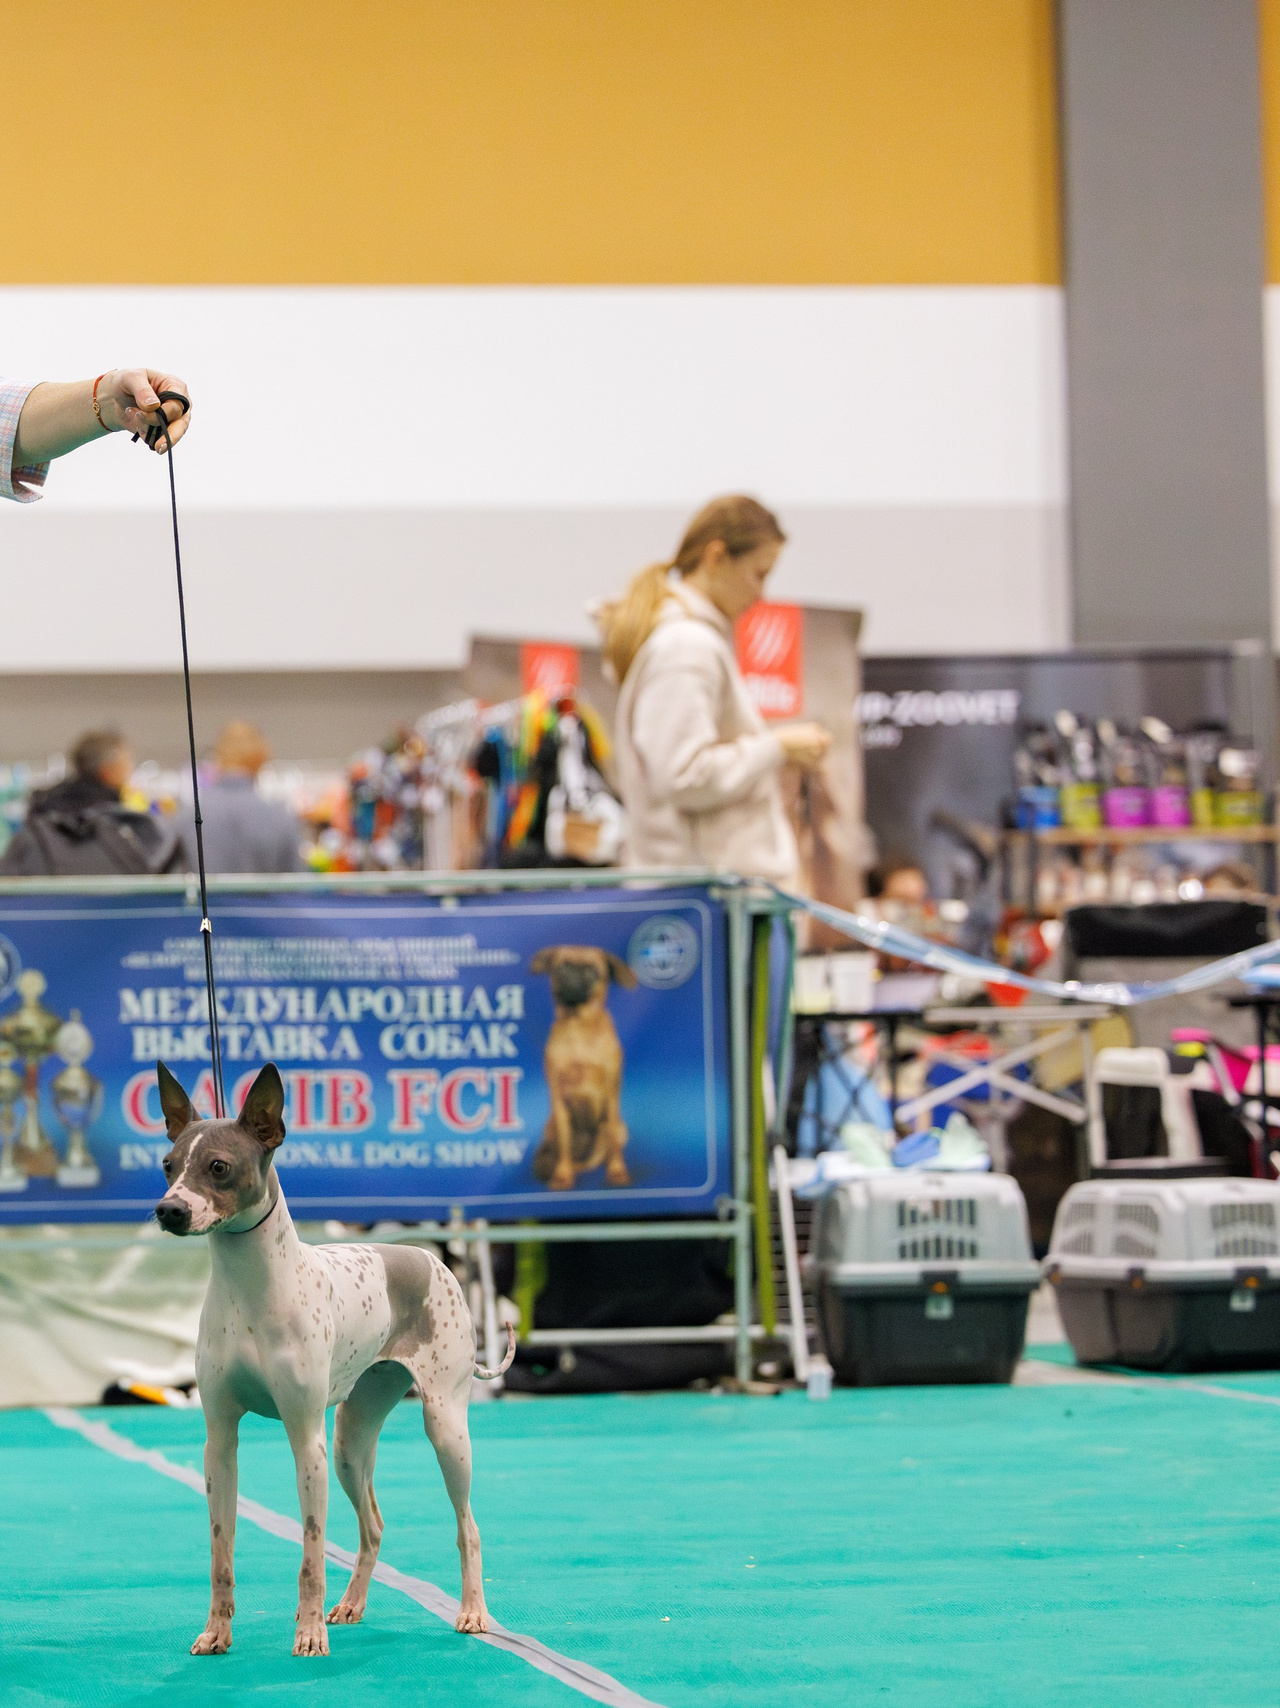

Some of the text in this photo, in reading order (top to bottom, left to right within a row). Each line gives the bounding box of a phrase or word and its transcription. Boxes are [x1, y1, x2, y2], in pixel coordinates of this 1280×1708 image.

[120, 985, 525, 1024] МЕЖДУНАРОДНАЯ
[132, 1022, 519, 1061] ВЫСТАВКА СОБАК
[386, 1066, 523, 1132] FCI
[364, 1140, 431, 1168] DOG
[434, 1138, 527, 1167] SHOW
